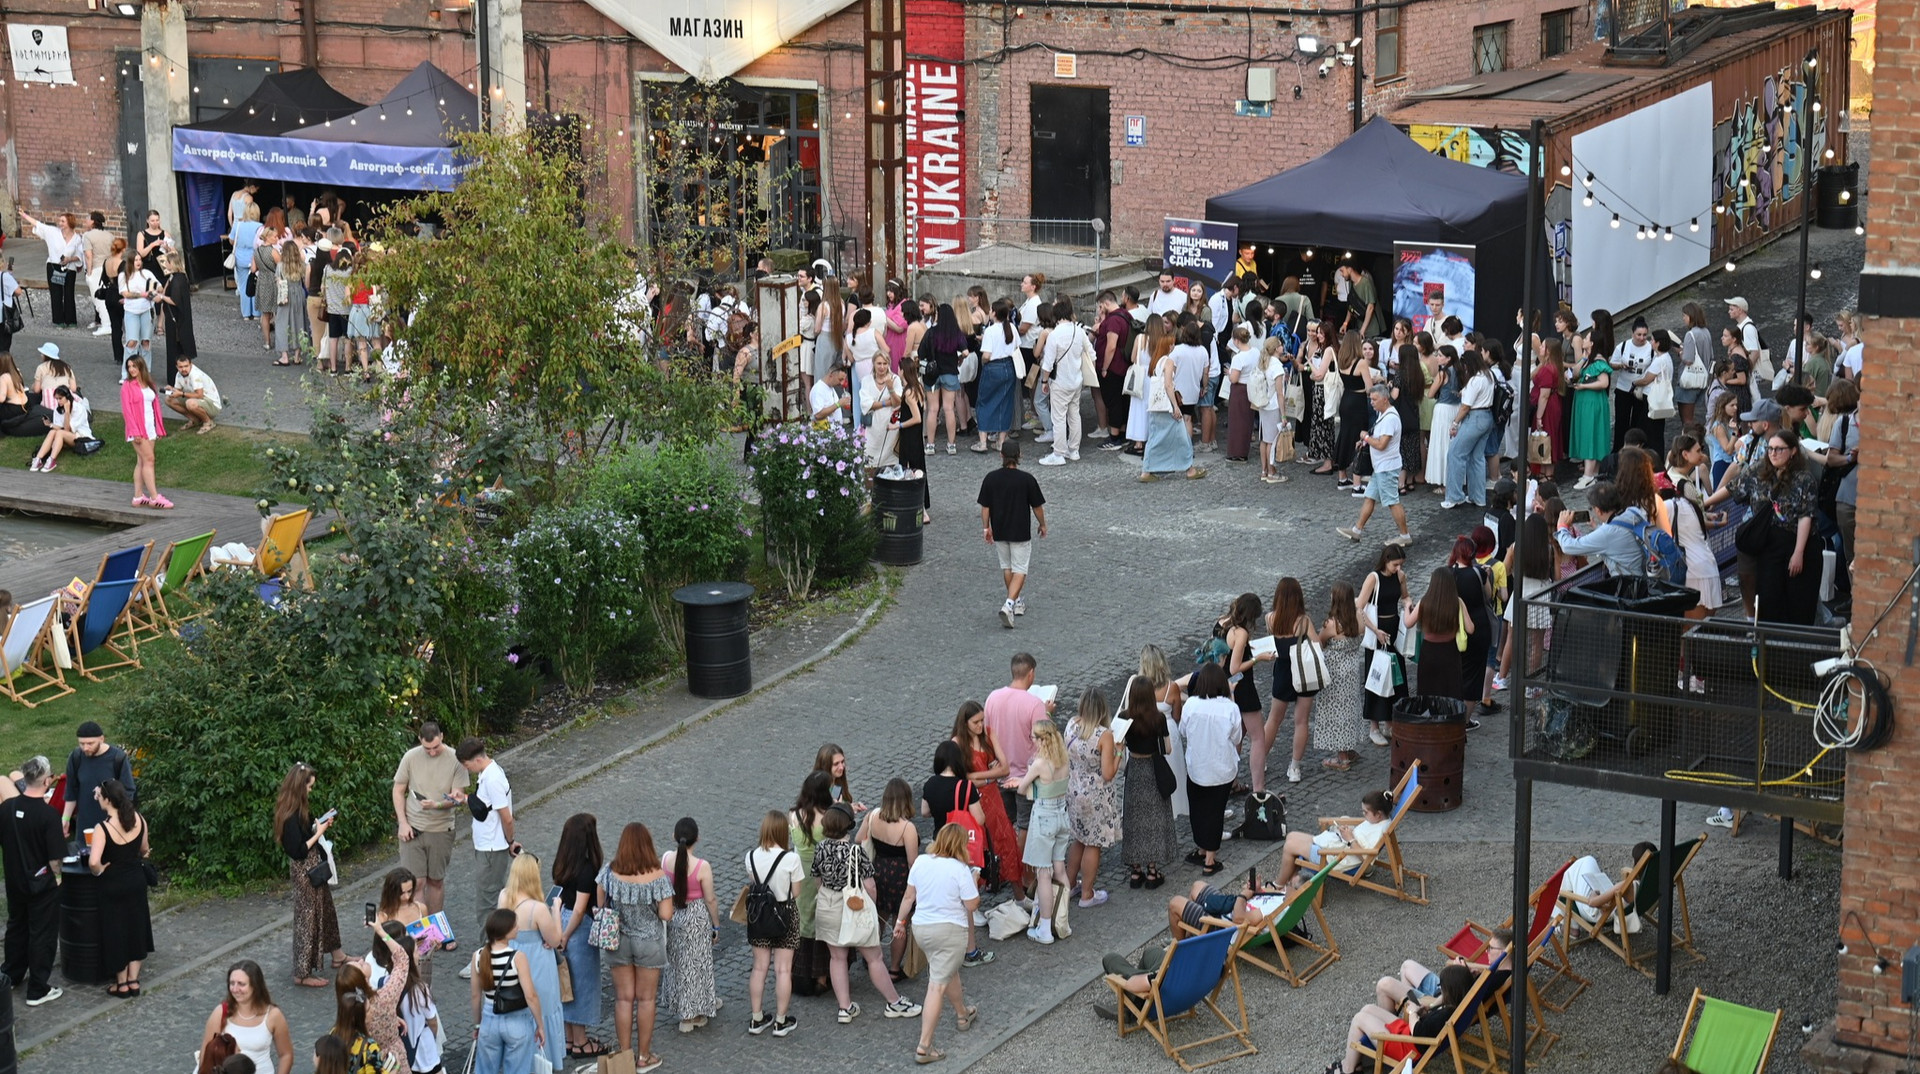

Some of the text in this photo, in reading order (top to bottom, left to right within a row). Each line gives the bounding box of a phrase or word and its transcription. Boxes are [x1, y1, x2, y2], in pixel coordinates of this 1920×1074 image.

[669, 17, 743, 38] МАГАЗИН
[920, 64, 960, 225] UKRAINE
[183, 144, 328, 168] Автограф-сесії. Локація 2
[349, 159, 439, 176] Автограф-сесії.
[1169, 235, 1229, 251] ЗМІЦНЕННЯ
[1169, 245, 1202, 257] ЧЕРЕЗ
[1169, 255, 1214, 269] ЄДНІСТЬ
